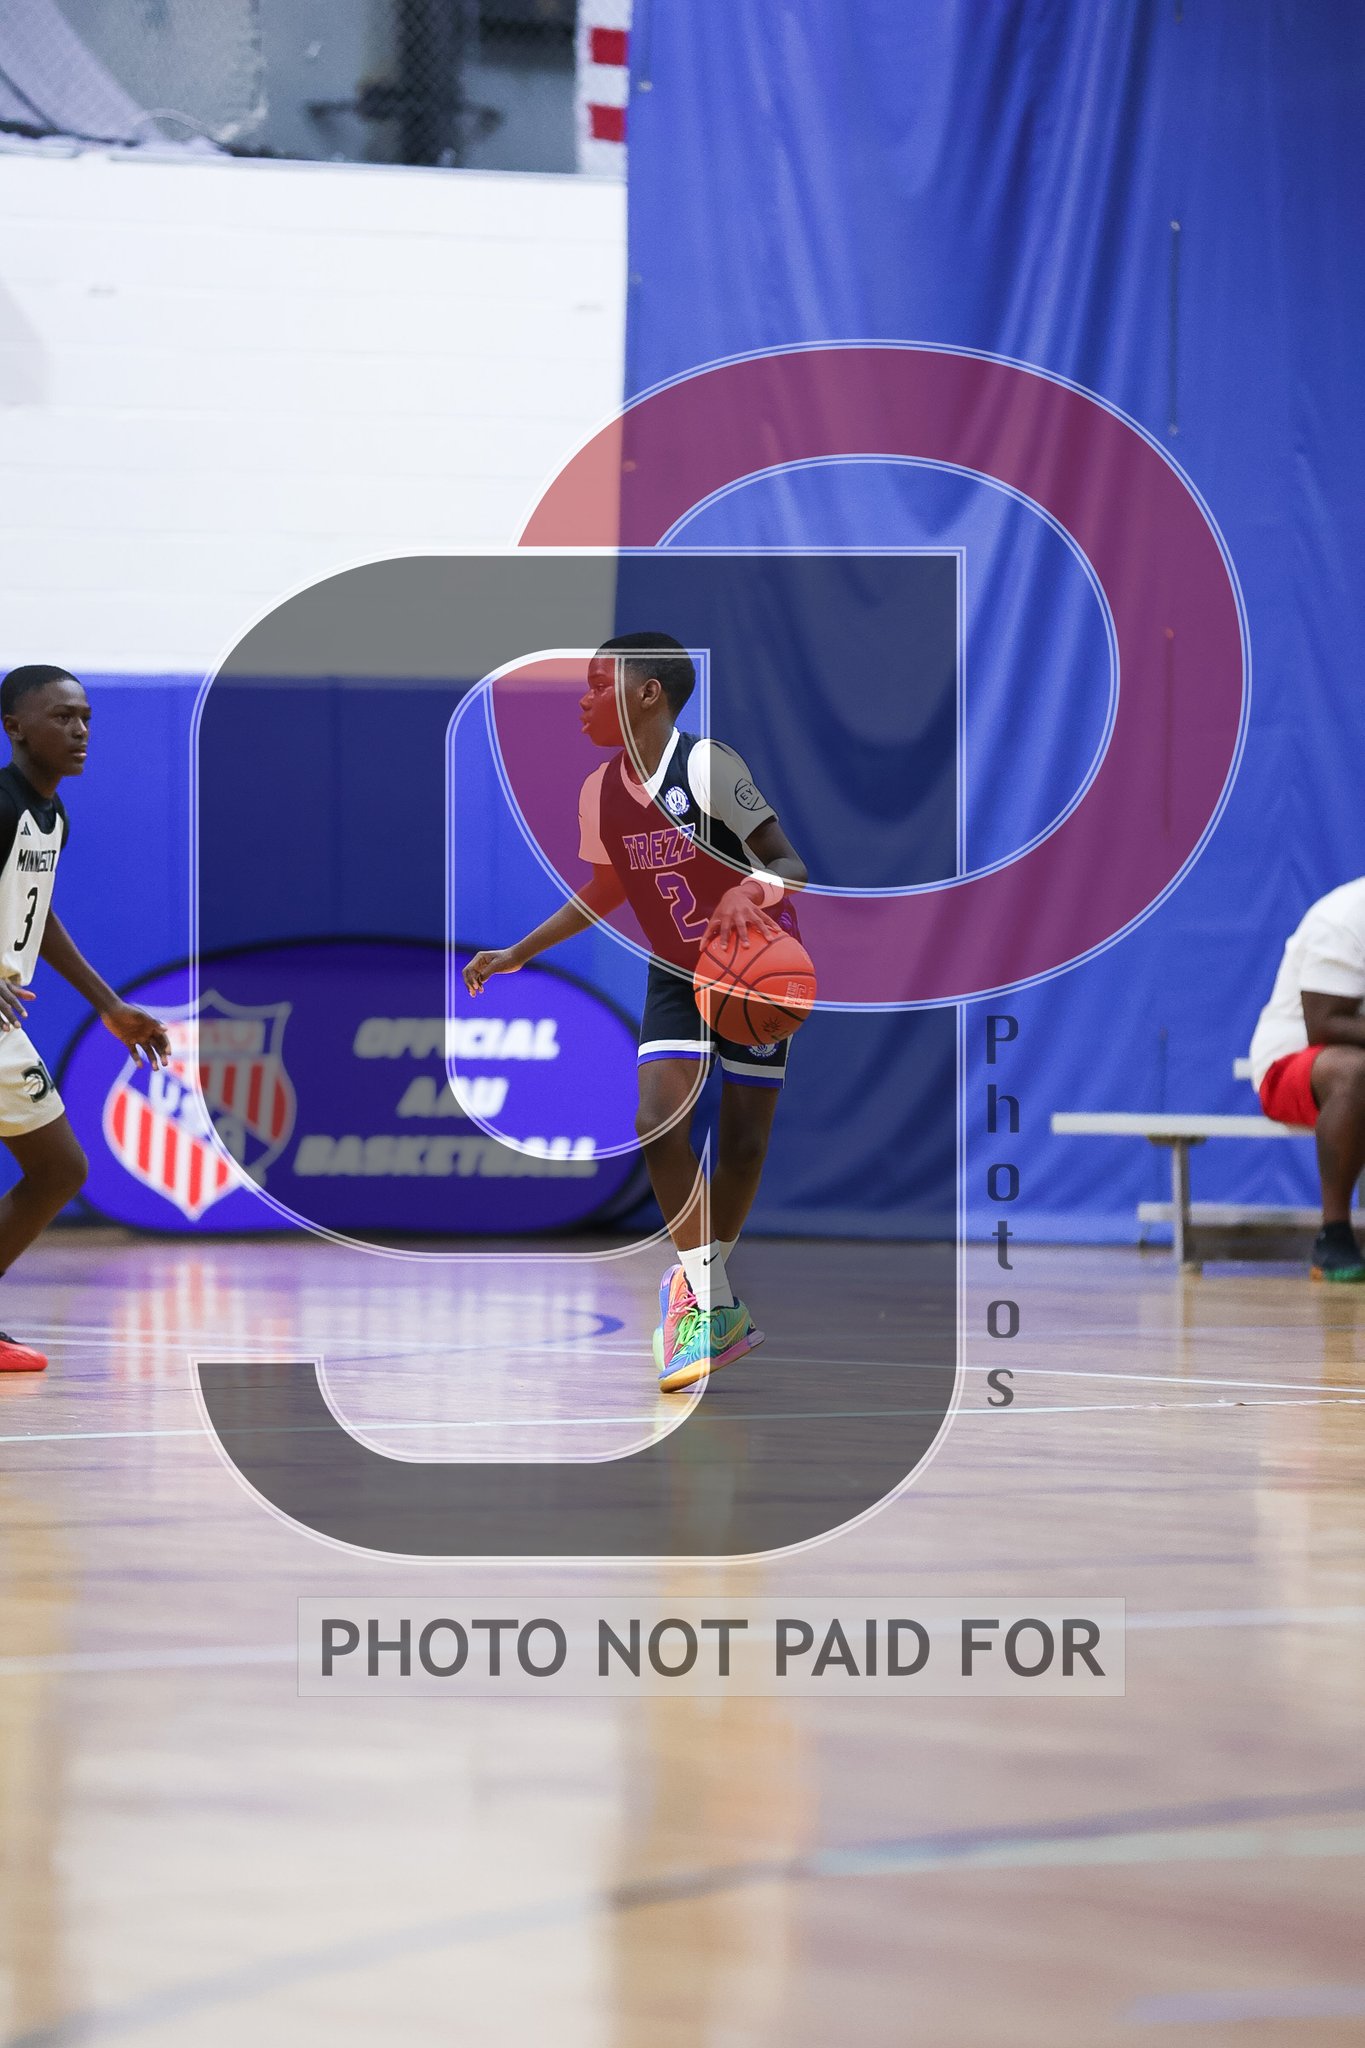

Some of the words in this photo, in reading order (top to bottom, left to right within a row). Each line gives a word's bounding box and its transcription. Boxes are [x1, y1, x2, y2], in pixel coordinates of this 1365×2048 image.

[622, 822, 696, 870] TREZZ
[13, 886, 38, 952] 3
[654, 871, 710, 943] 2
[353, 1017, 560, 1060] OFFICIAL
[396, 1076, 509, 1118] AAU
[293, 1135, 599, 1177] BASKETBALL
